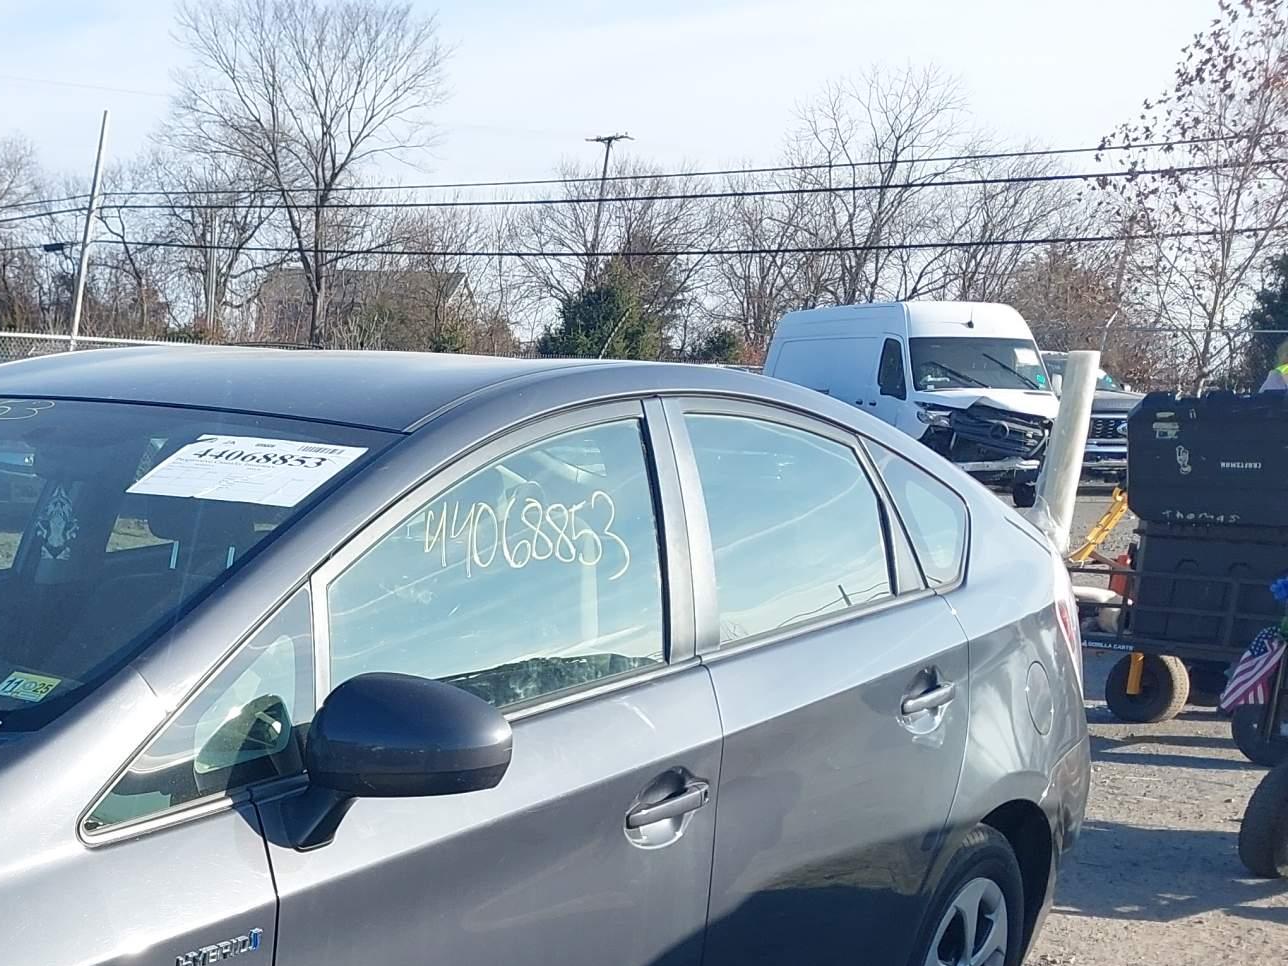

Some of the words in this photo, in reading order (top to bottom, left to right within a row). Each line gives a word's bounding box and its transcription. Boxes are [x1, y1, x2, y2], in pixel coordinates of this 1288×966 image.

[193, 447, 327, 469] 44068853
[424, 490, 630, 580] 44068853
[32, 682, 53, 694] 25
